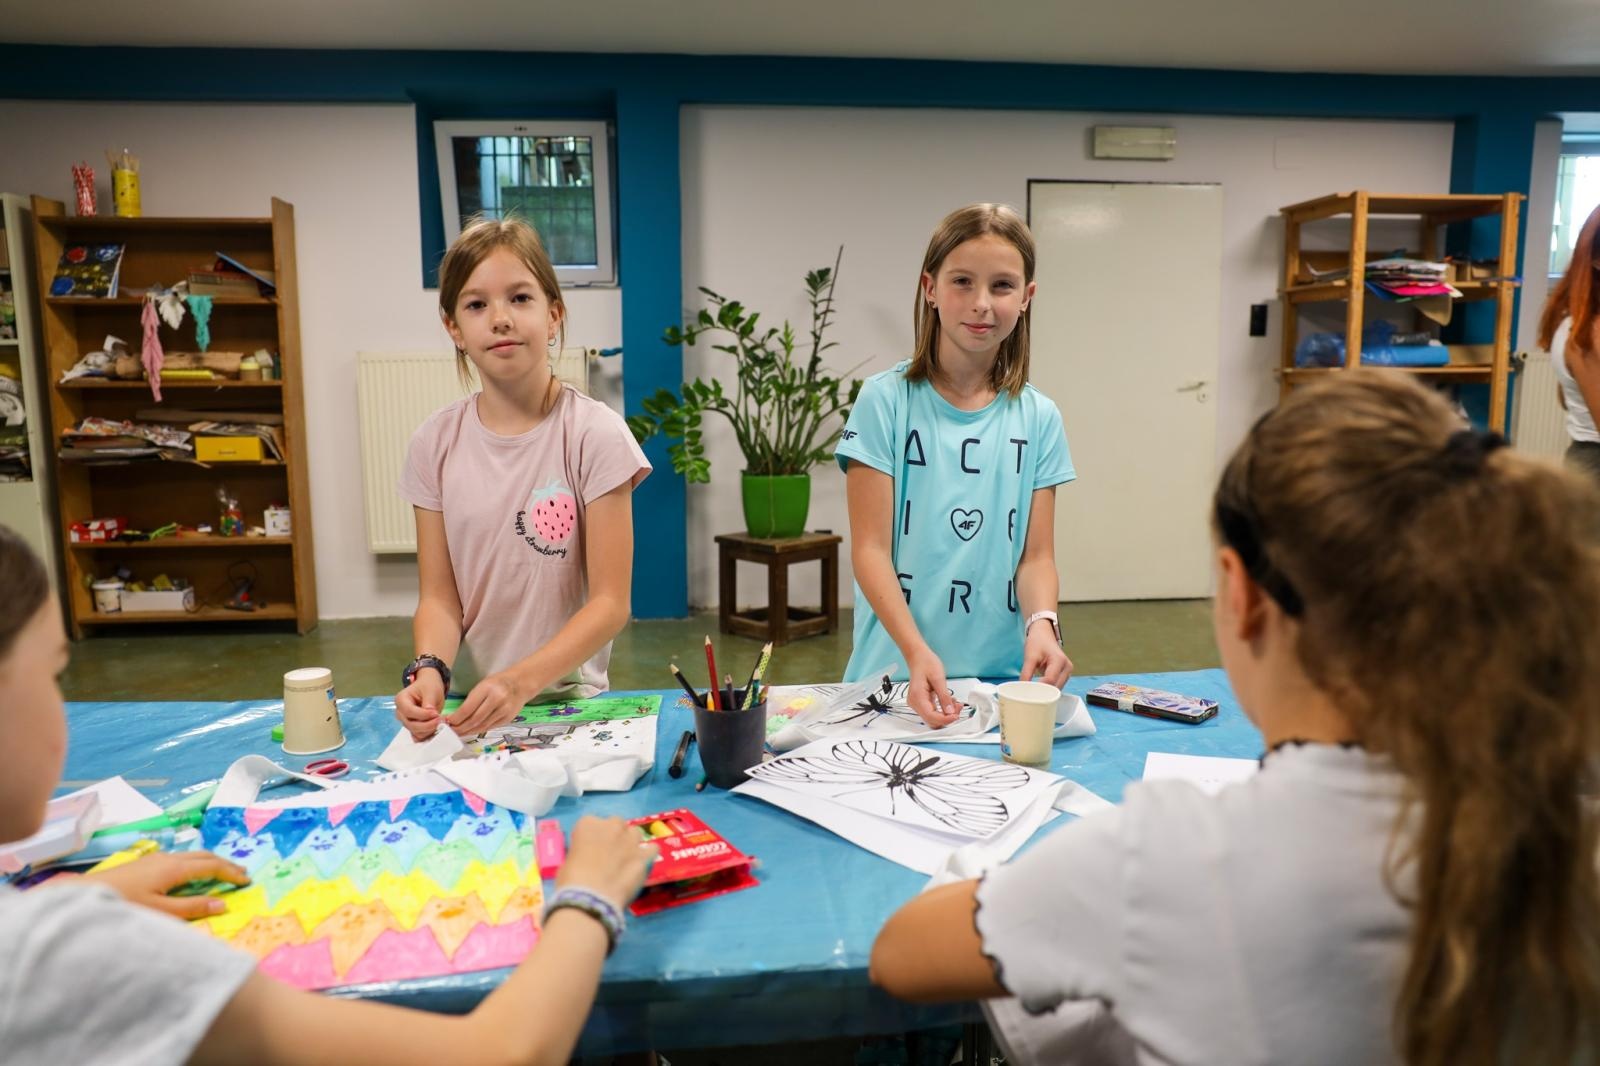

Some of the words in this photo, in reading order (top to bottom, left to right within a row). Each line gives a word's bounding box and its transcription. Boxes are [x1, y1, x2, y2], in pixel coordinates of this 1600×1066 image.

[515, 511, 527, 536] happy
[525, 537, 568, 559] strawberry
[958, 520, 977, 531] 4F
